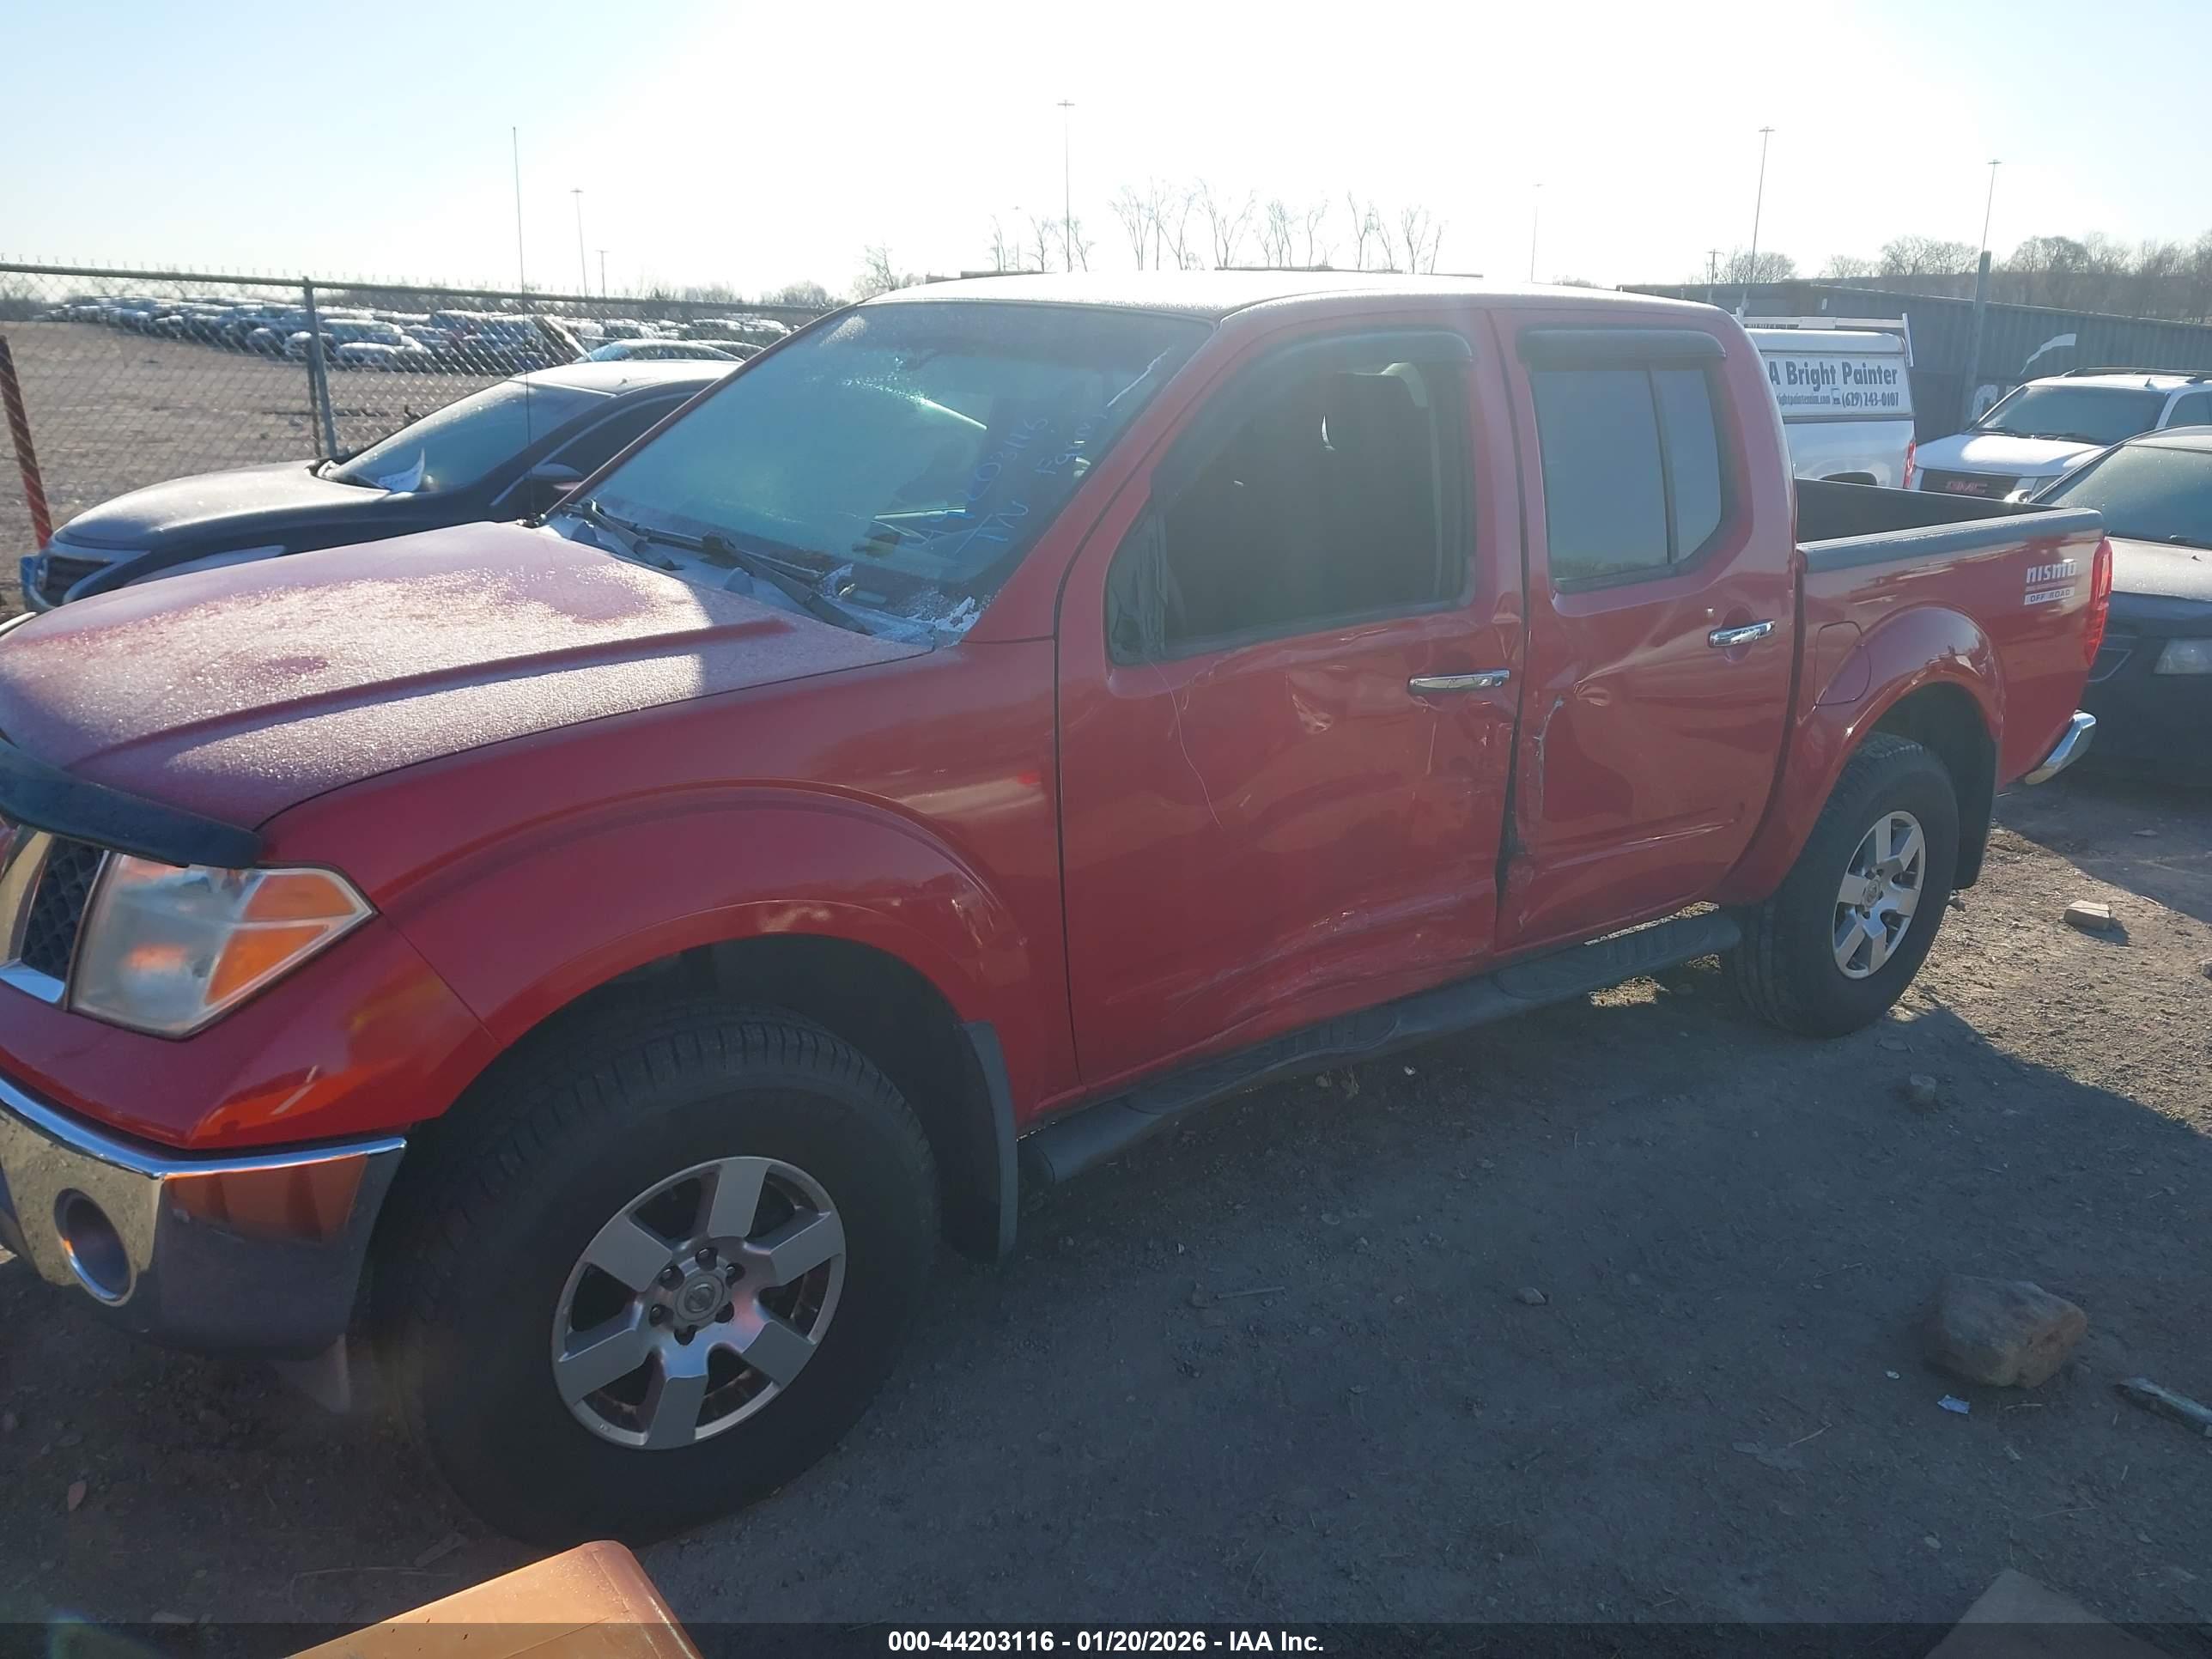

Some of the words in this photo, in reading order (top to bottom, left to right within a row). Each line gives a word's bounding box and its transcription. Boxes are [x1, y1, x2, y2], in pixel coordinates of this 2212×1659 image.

[1769, 361, 1781, 385] A
[1785, 361, 1837, 392] Bright
[1841, 361, 1899, 385] Painter
[1945, 481, 1988, 495] GMC
[2030, 593, 2045, 603] OFF
